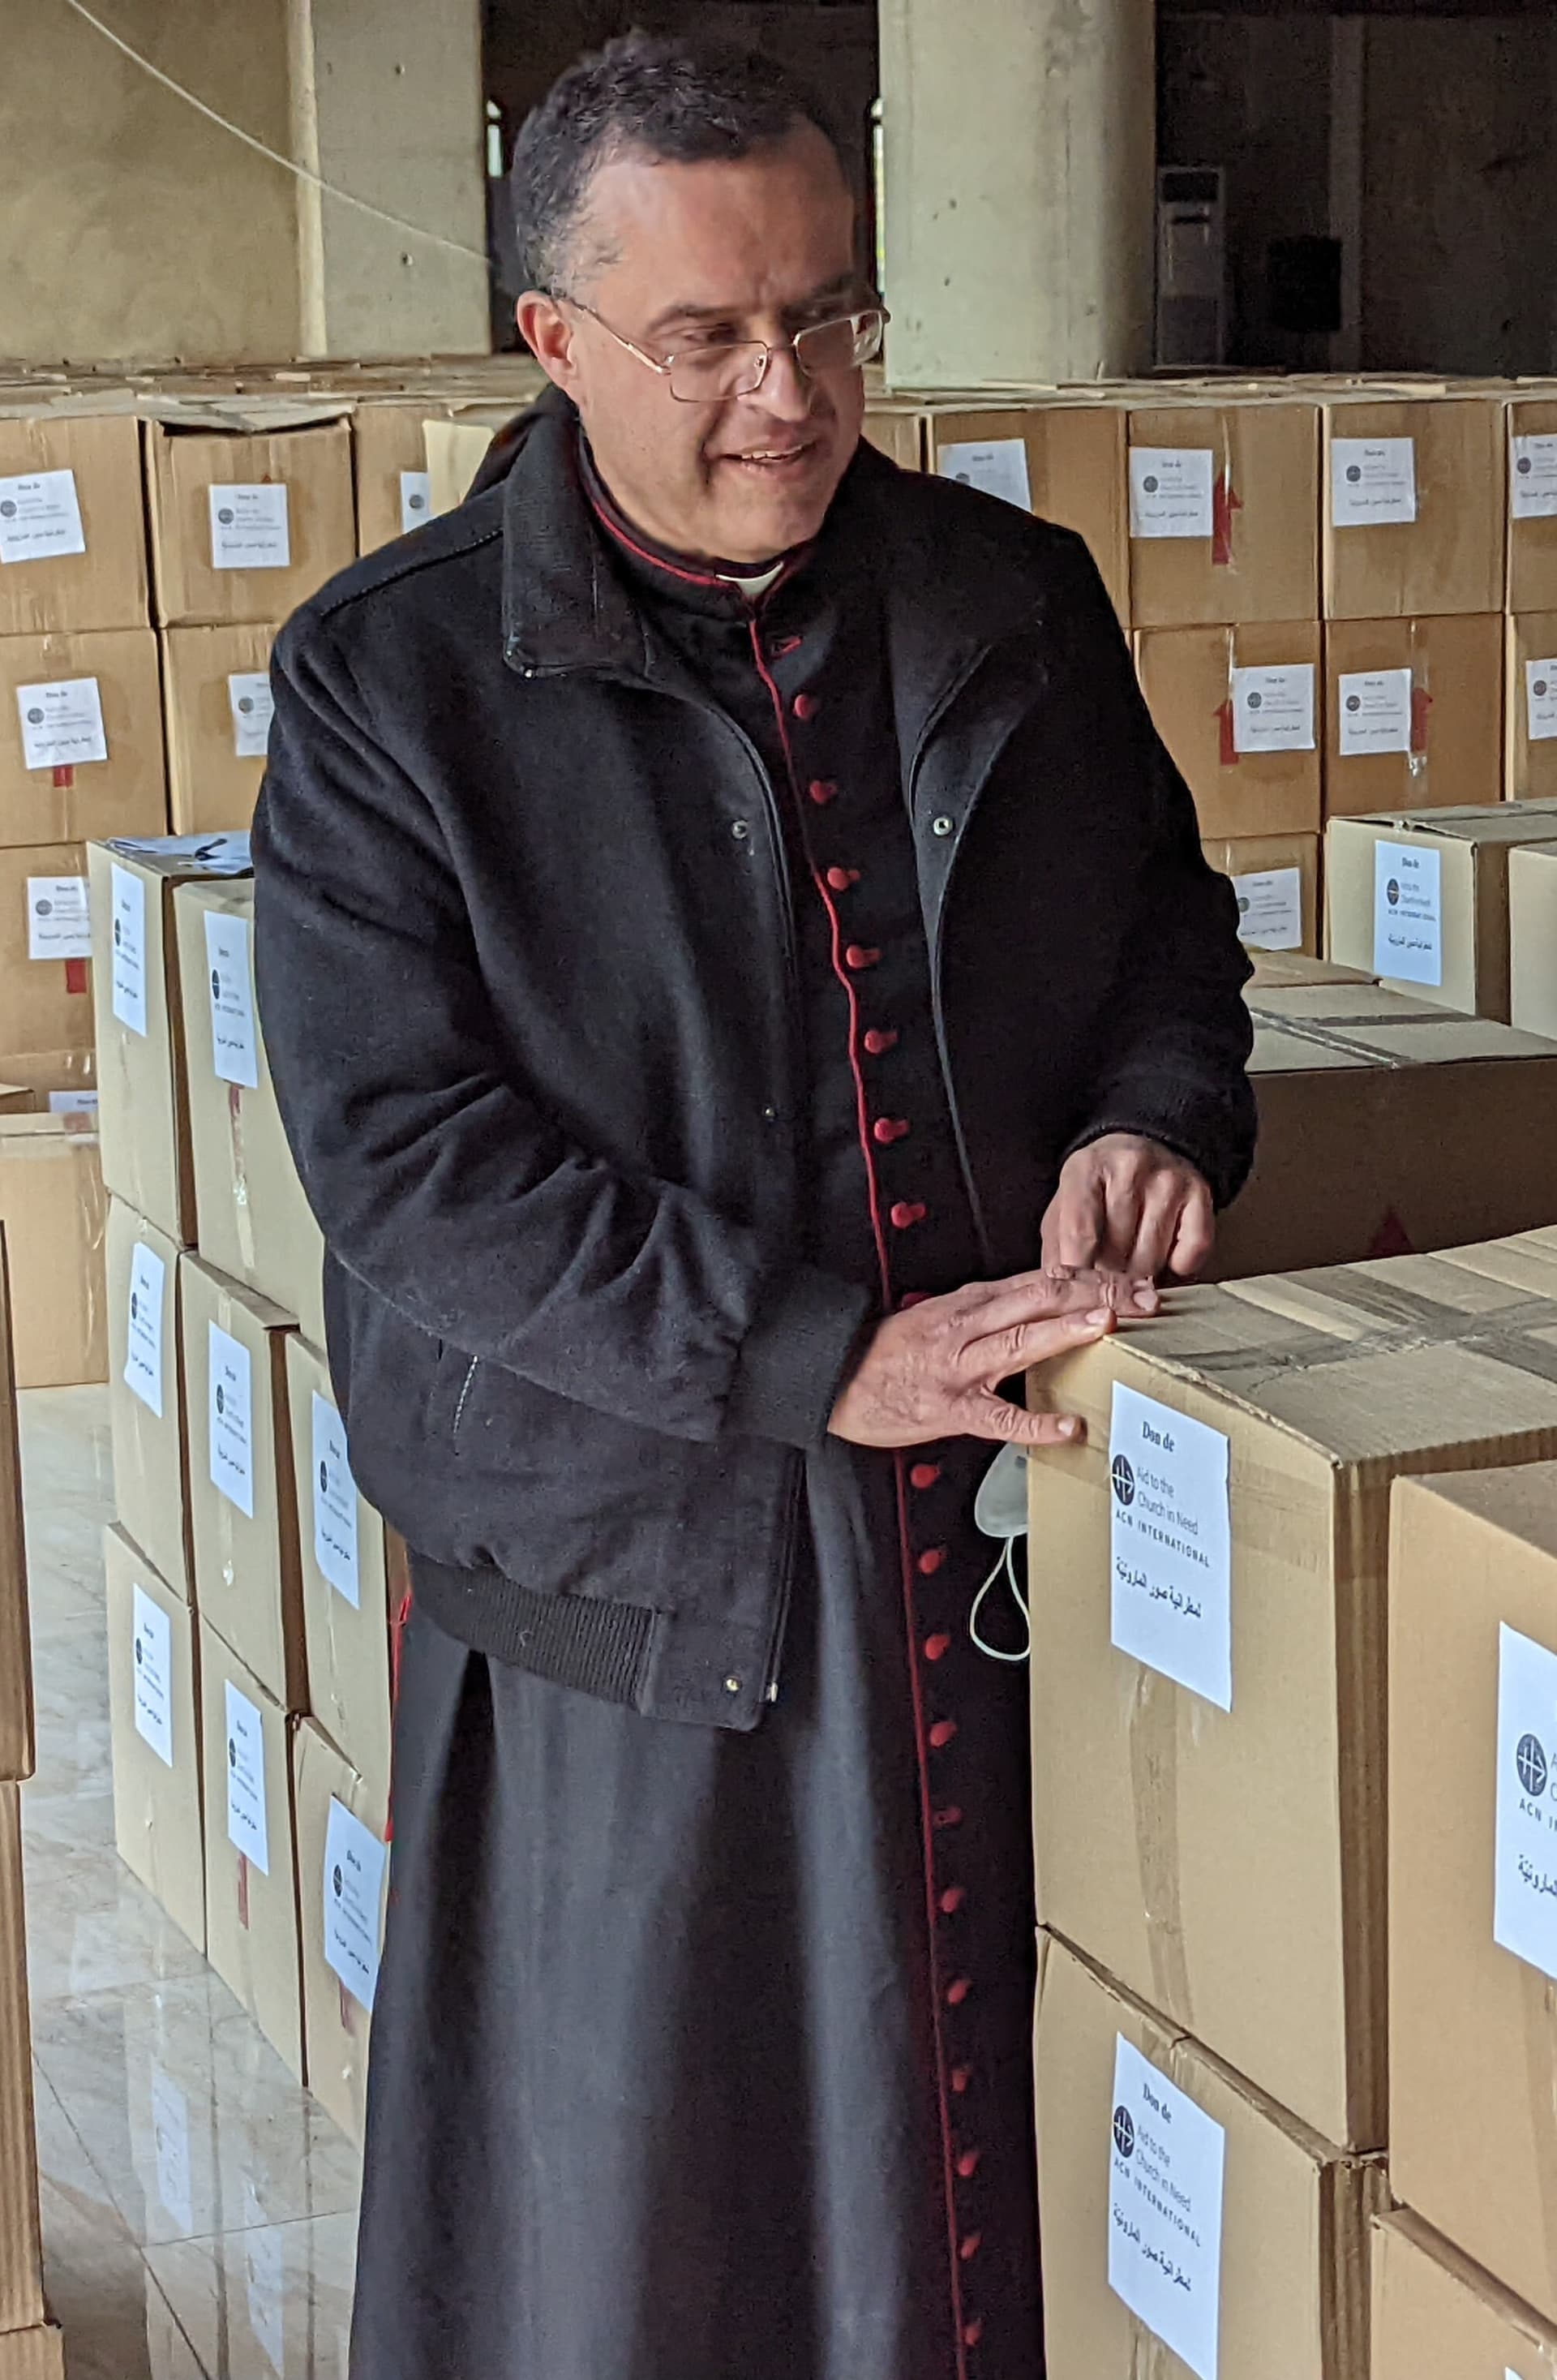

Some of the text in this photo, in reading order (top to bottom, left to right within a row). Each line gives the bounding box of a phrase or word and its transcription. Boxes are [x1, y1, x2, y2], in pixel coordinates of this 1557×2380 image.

[1142, 1420, 1174, 1452] Don de
[1137, 1466, 1174, 1498] Aid to the
[1138, 1491, 1198, 1536] Church in Need
[1116, 1510, 1209, 1568] ACN INTERNATIONAL
[1519, 1798, 1541, 1821] ACN
[1143, 2082, 1172, 2124] Don de
[1136, 2149, 1160, 2182] Church
[1114, 2157, 1200, 2247] ACN INTERNATIONAL
